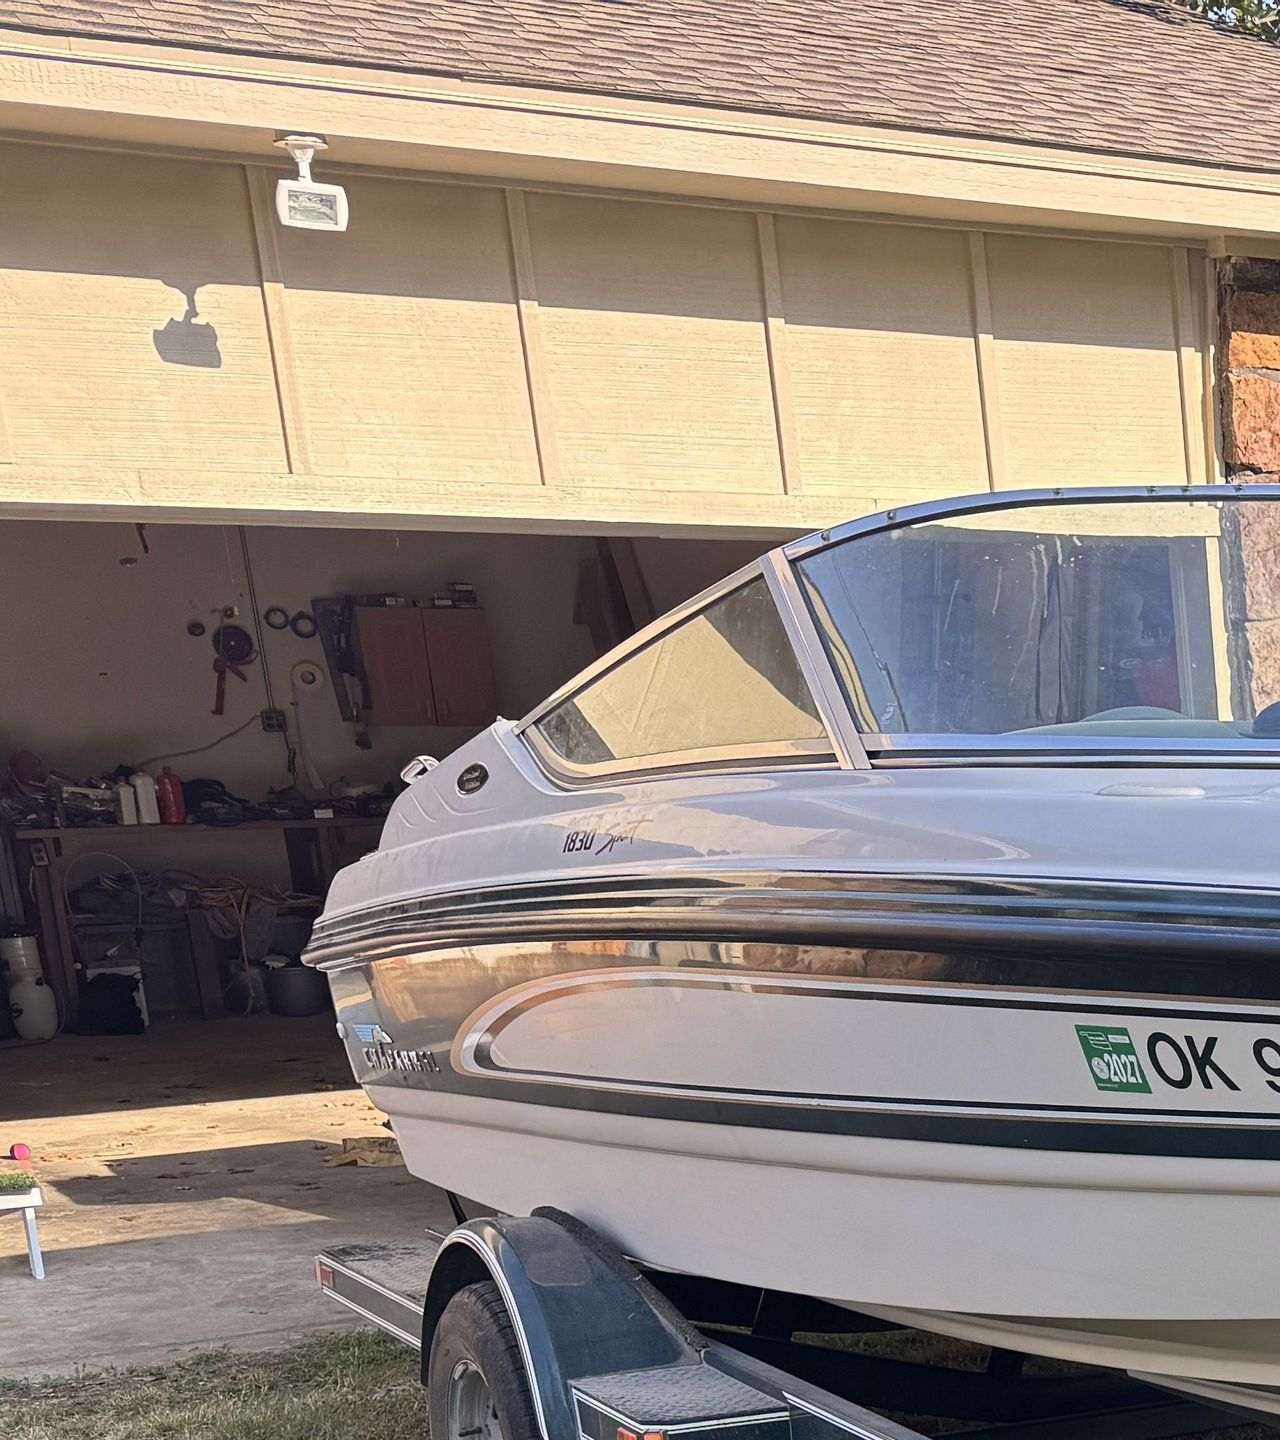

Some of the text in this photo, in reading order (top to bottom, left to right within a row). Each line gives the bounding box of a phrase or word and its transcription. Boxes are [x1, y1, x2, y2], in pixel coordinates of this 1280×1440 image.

[562, 829, 597, 853] 1830
[1103, 1052, 1143, 1084] 2027
[1146, 1031, 1241, 1092] OK
